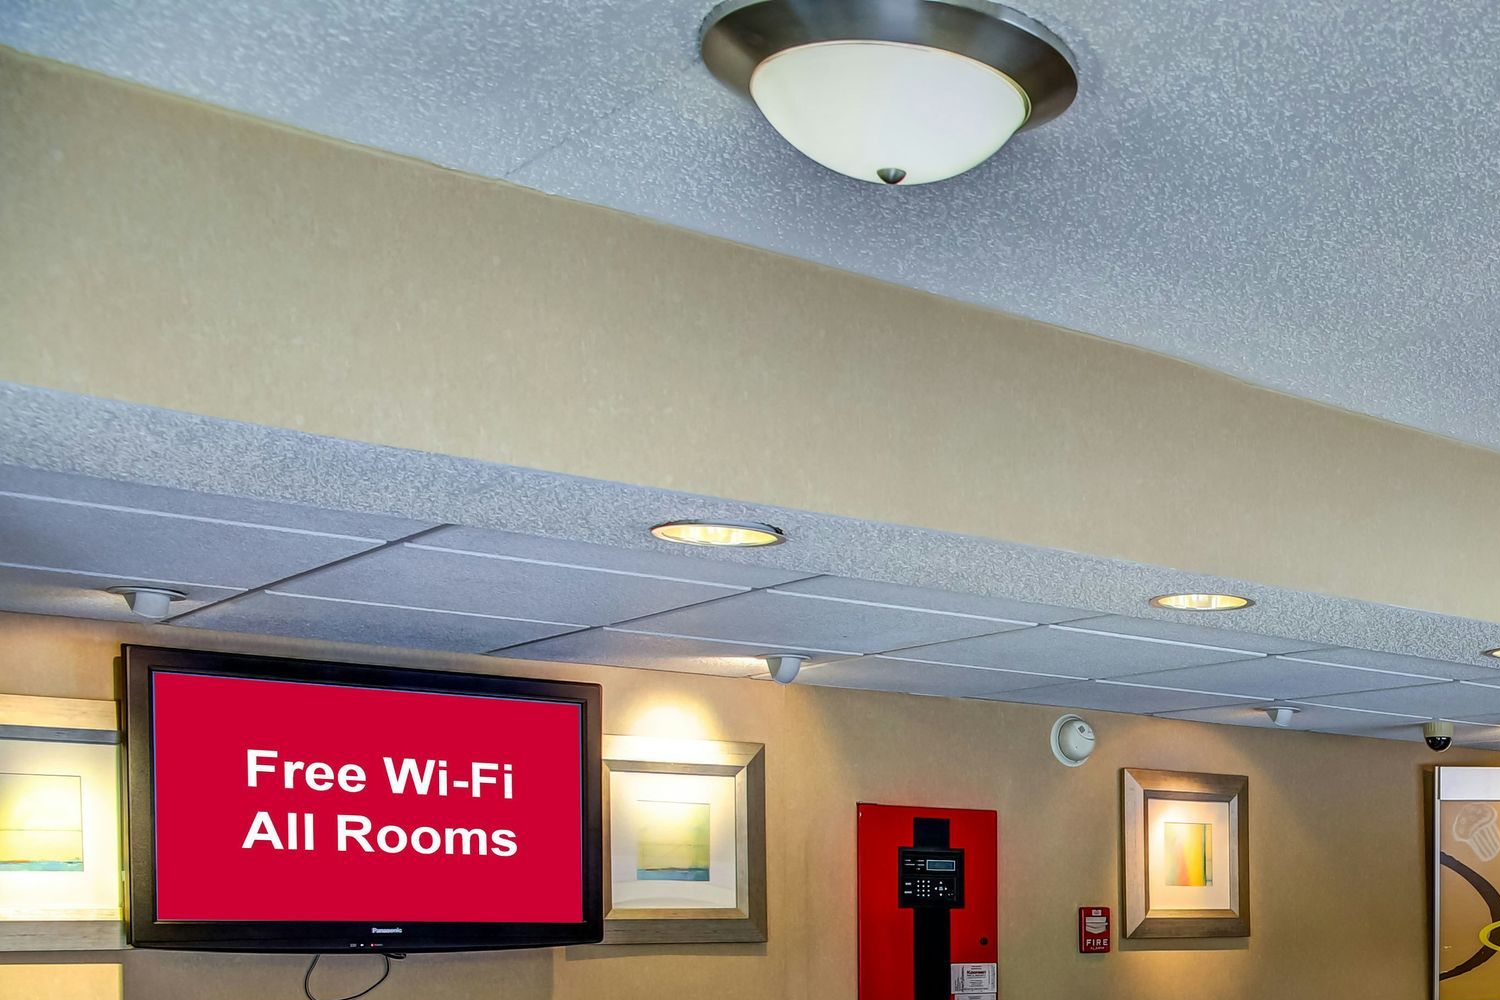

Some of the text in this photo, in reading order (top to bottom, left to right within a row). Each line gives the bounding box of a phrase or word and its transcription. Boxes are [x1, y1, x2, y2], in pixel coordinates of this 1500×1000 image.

[245, 749, 514, 799] Free Wi-Fi
[241, 811, 518, 857] All Rooms
[1086, 938, 1109, 946] FIRE
